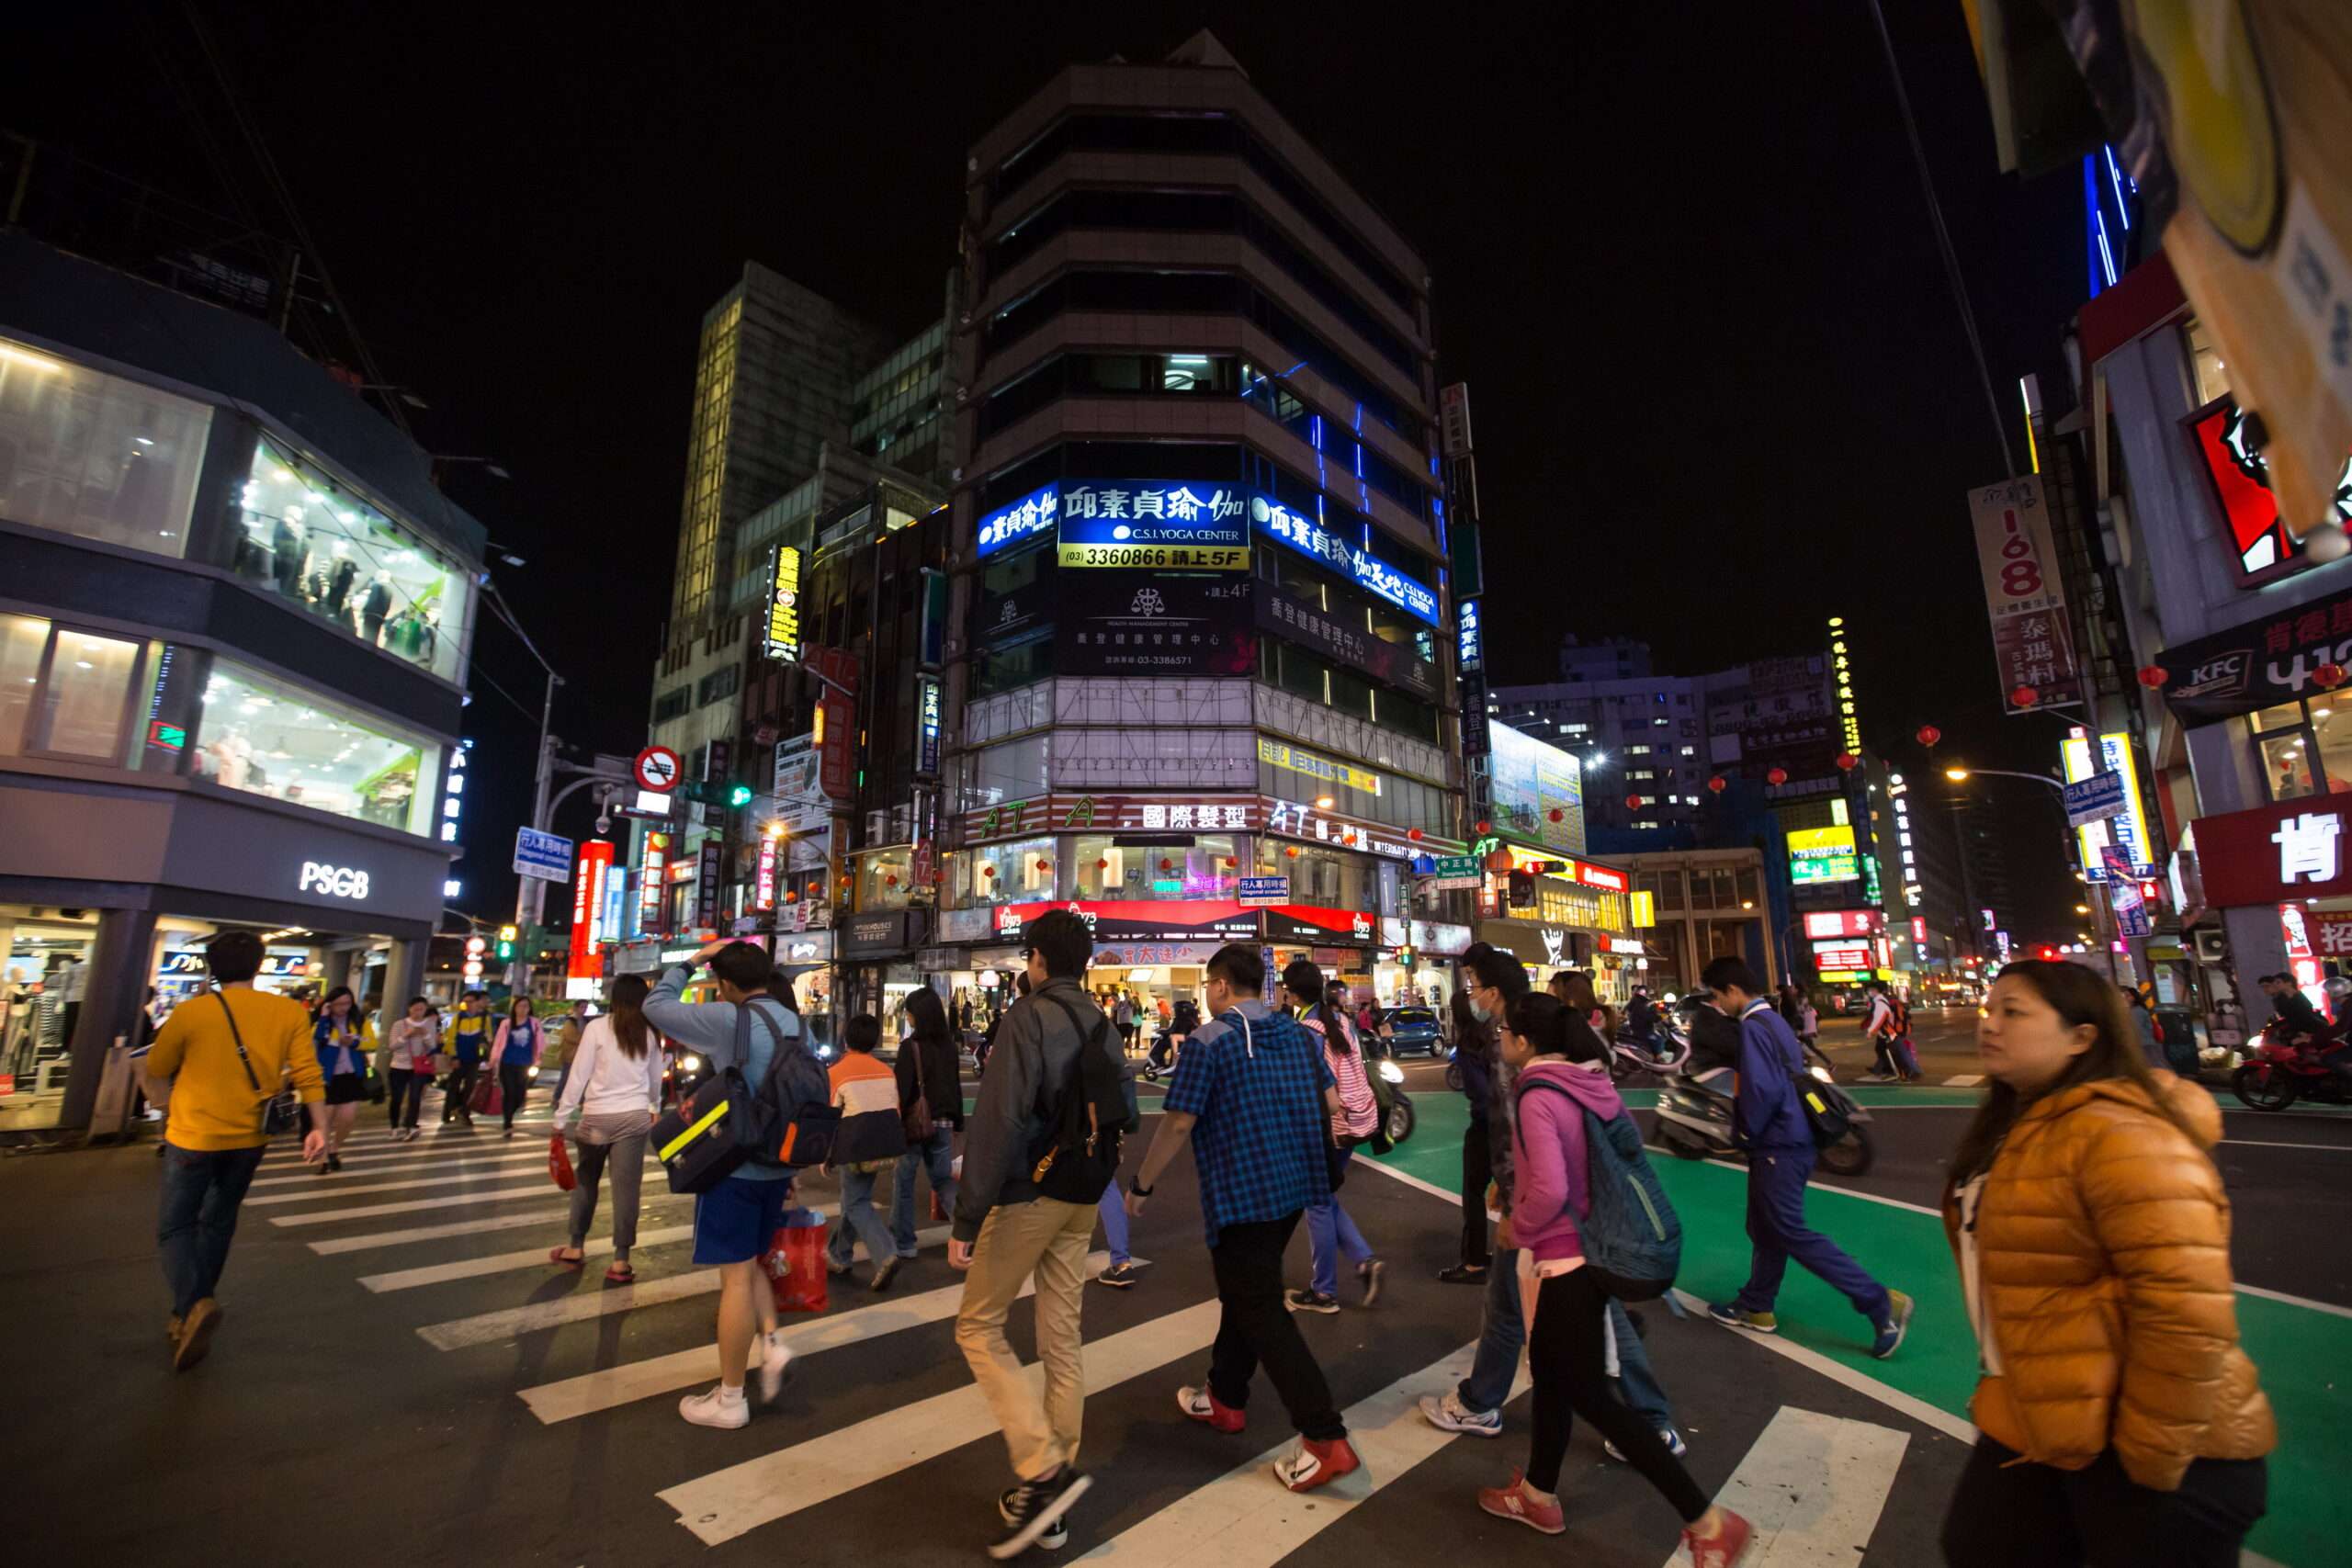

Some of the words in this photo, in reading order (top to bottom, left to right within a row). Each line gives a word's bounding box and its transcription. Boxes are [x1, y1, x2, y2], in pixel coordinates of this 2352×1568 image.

[1064, 486, 1243, 521] 邱素貞瑜伽
[1159, 529, 1194, 540] YOGA
[1196, 530, 1239, 541] CENTER
[1066, 551, 1084, 562] (03)
[1086, 549, 1165, 566] 3360866
[2002, 510, 2041, 596] 168
[1408, 595, 1430, 615] CENTER
[1136, 655, 1192, 665] 03-3386571
[2189, 656, 2240, 685] KFC
[1142, 805, 1247, 829] 國際髮型
[2271, 813, 2340, 883] 肯
[299, 861, 369, 899] PSGB
